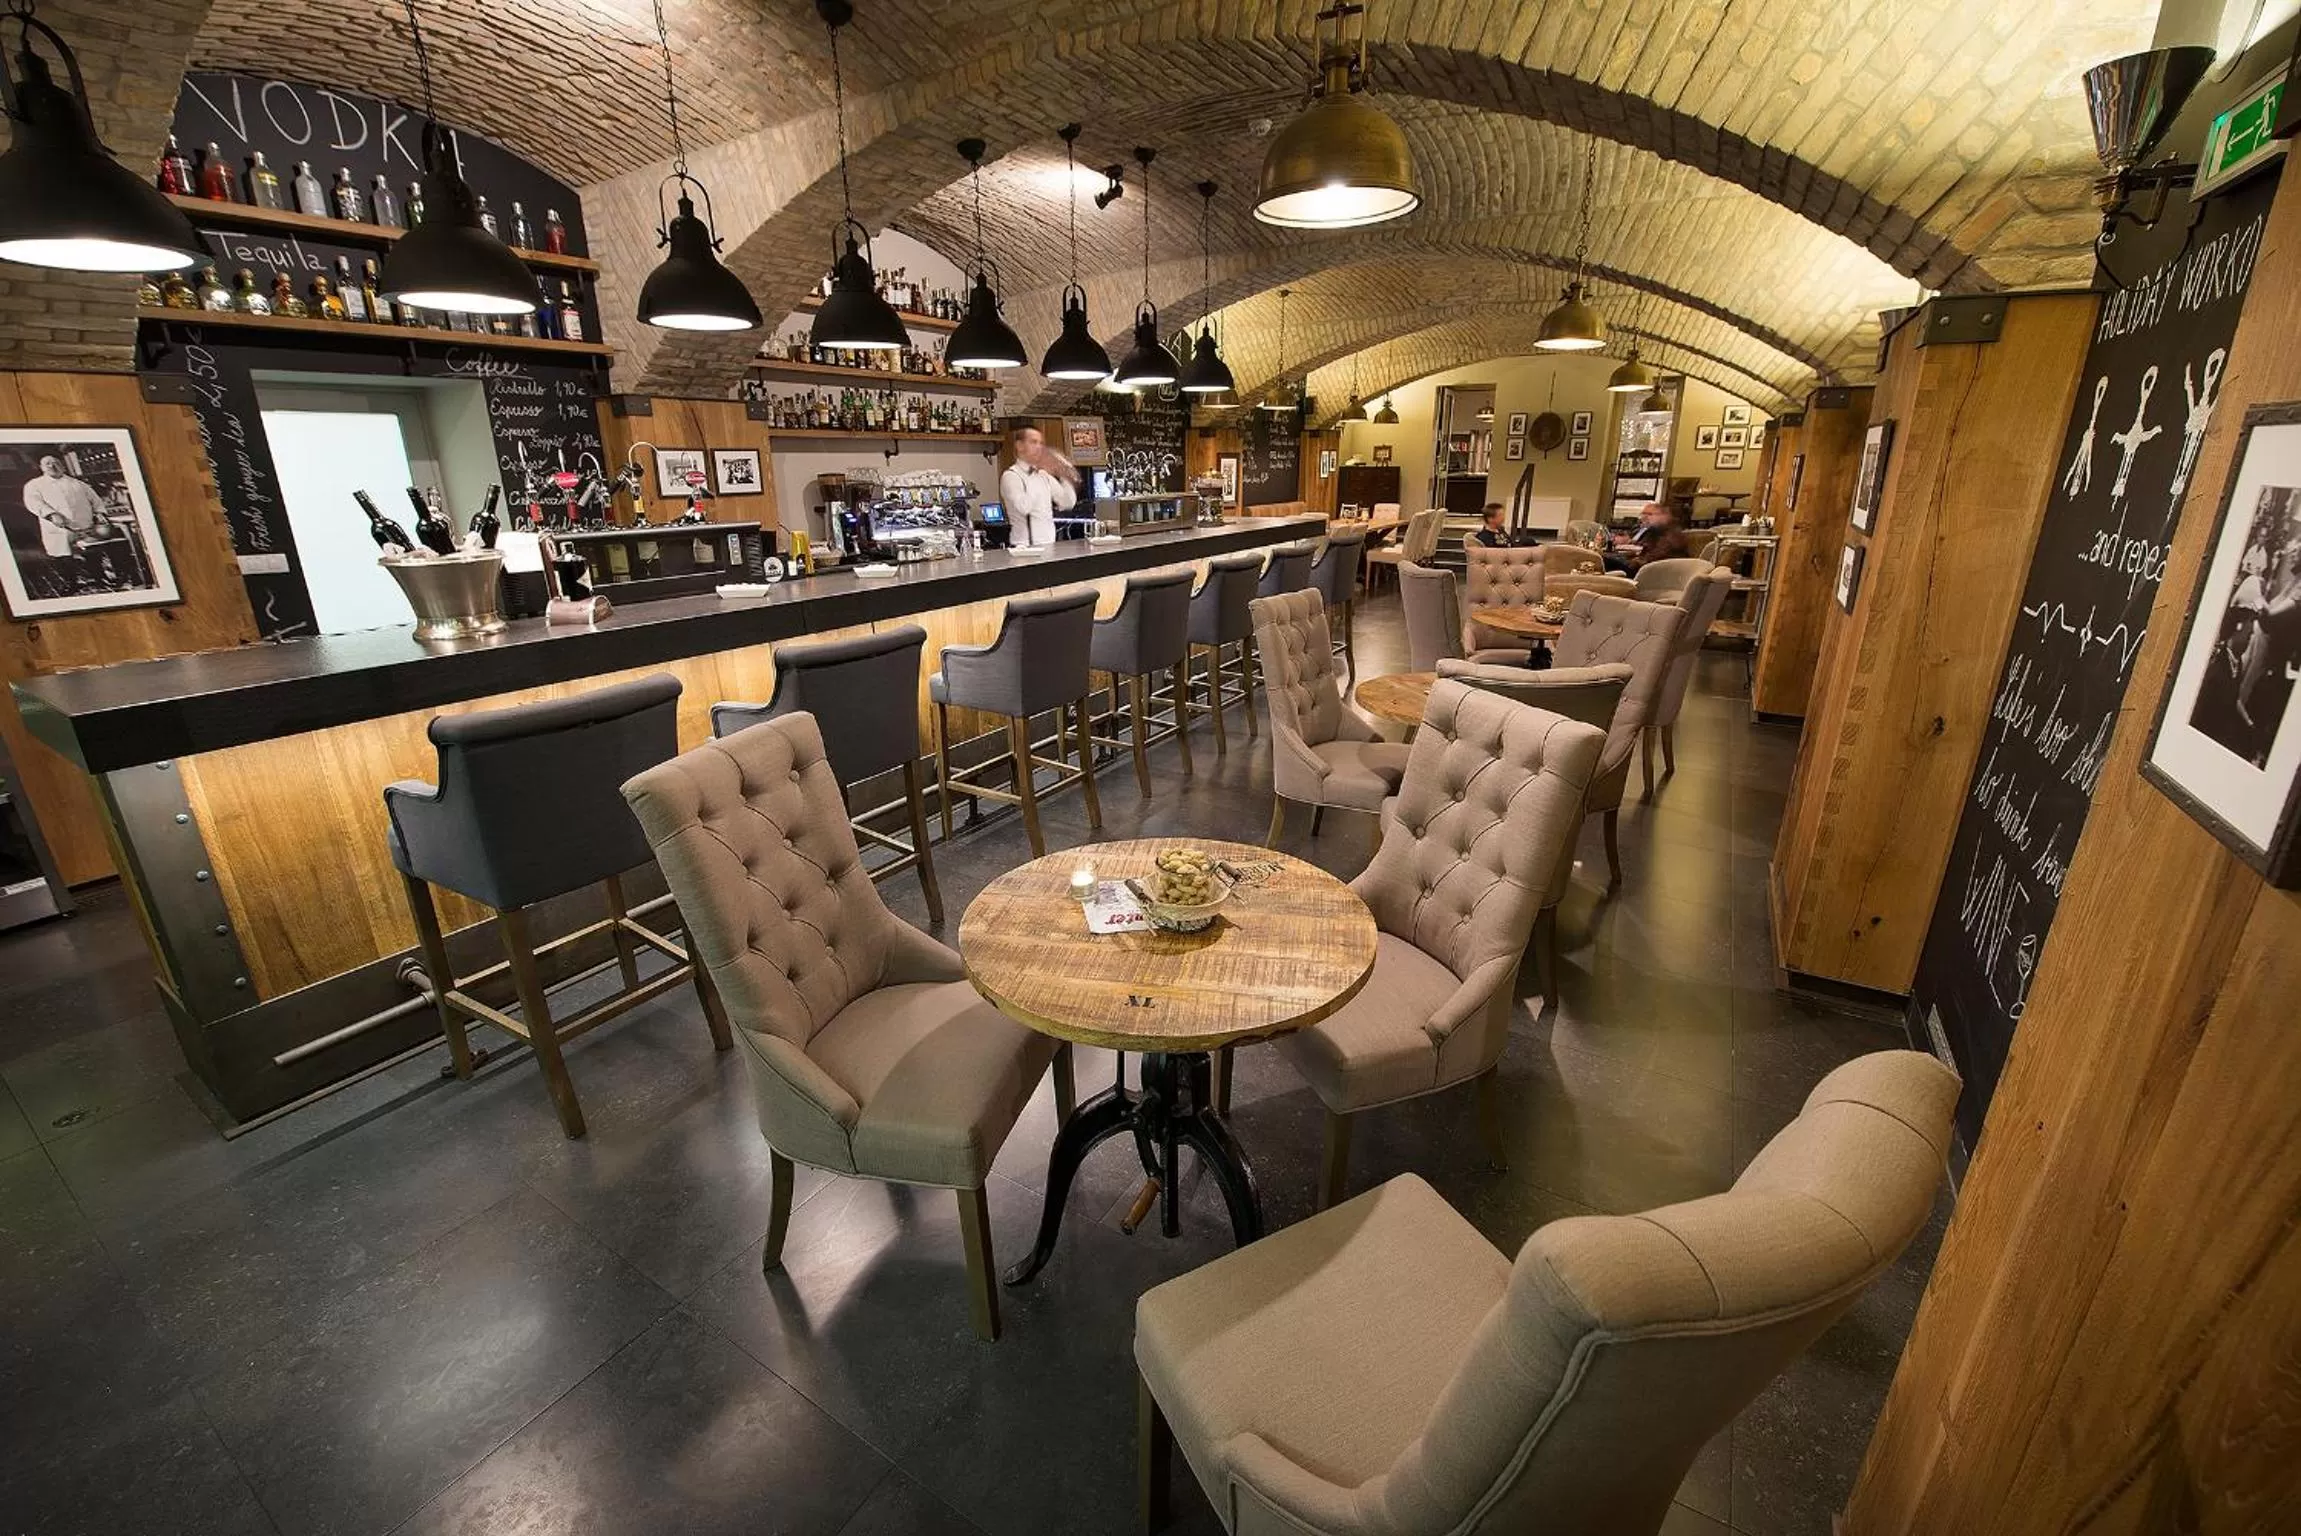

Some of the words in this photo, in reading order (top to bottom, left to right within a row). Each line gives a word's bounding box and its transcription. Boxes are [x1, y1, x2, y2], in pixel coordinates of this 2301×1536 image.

[198, 228, 329, 275] Tequila
[2097, 259, 2178, 344] HOLIDAY
[221, 412, 246, 447] tea
[233, 449, 273, 503] ginger
[241, 506, 273, 552] Fresh
[2034, 683, 2080, 765] too
[1973, 746, 2004, 810] to
[1994, 773, 2039, 852] drink
[1961, 831, 2030, 1011] WINE
